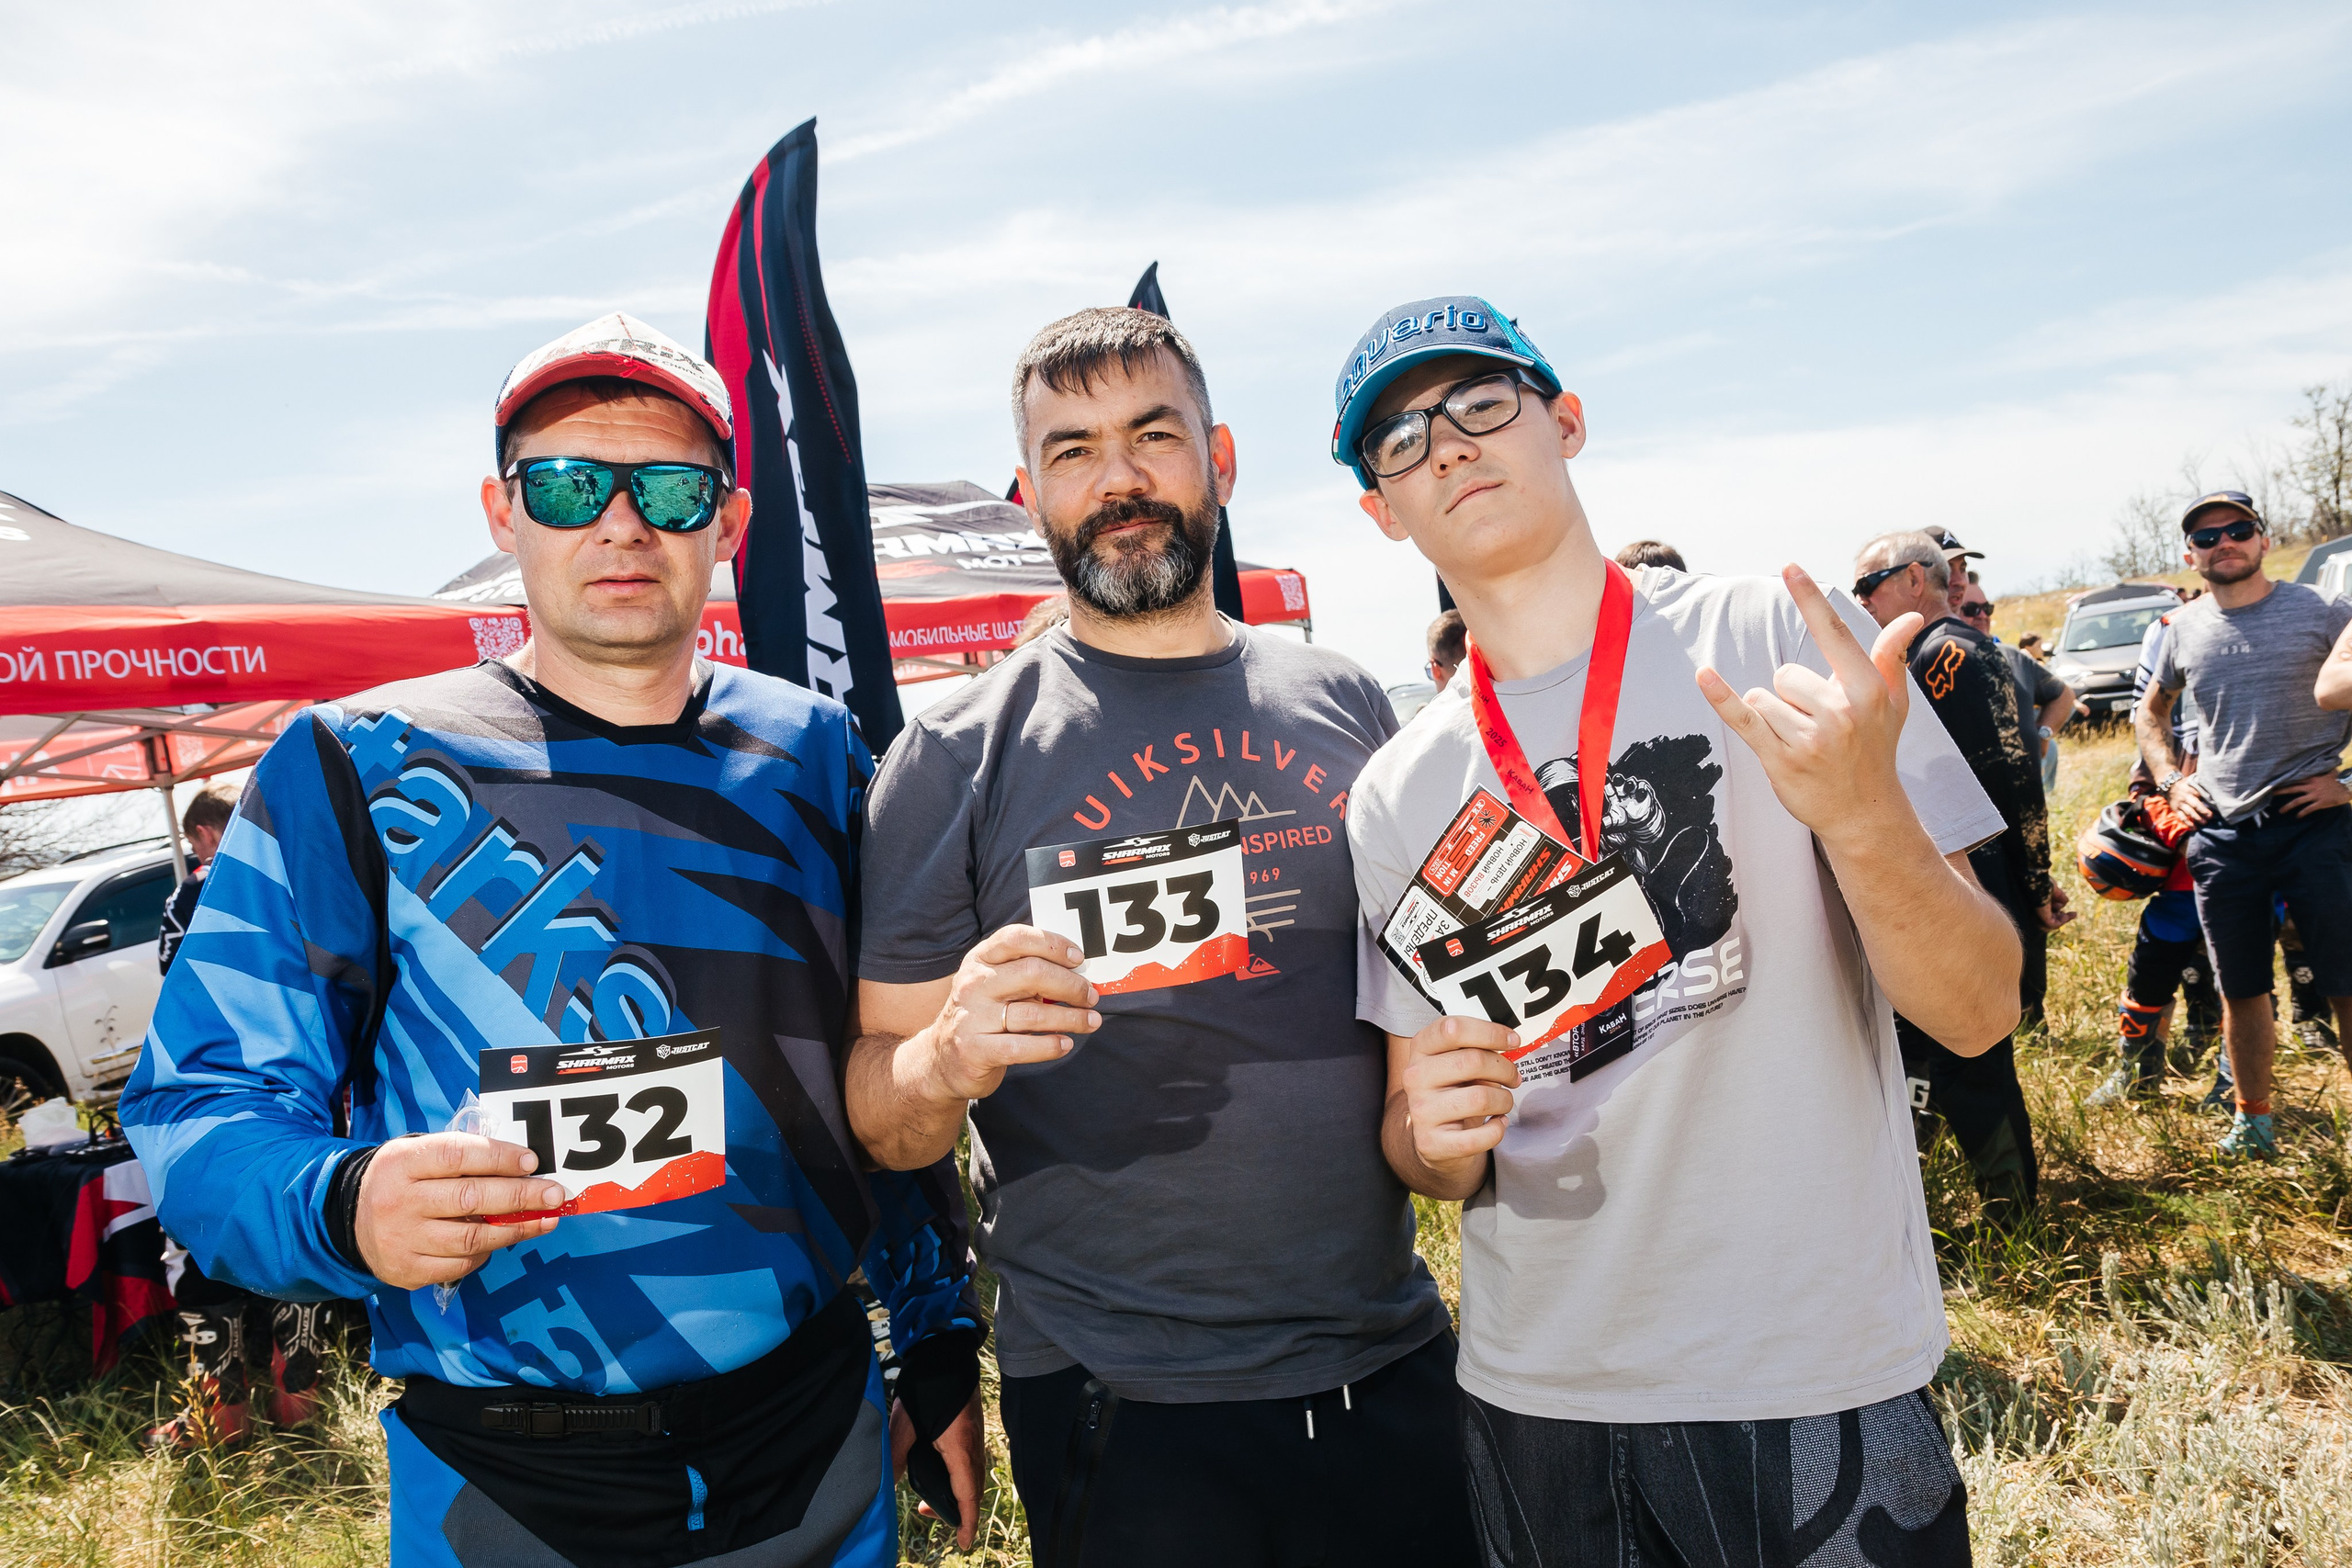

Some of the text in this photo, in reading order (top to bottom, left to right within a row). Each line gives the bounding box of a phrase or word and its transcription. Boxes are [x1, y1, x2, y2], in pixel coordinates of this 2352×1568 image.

[889, 619, 1026, 648] МОБИЛЬНЫЕ ШАТ
[54, 646, 266, 681] ПРОЧНОСТИ
[1486, 728, 1507, 748] 2025
[1102, 843, 1171, 861] SHARMAX
[1464, 831, 1486, 856] FREED
[1146, 852, 1170, 860] MOTORS
[1482, 846, 1504, 874] НОВЫЙ
[1490, 839, 1528, 885] НОВЫЙ ДЕНЬ
[1243, 867, 1281, 887] 969
[1464, 872, 1485, 897] ВЫЗОВ
[1064, 870, 1220, 959] 133
[1487, 904, 1553, 942] SHARMAX
[1530, 910, 1555, 927] MOTORS
[1403, 908, 1439, 957] ПРЕДЕЛЫ
[1434, 919, 1451, 935] ЗА
[1459, 911, 1636, 1029] 134
[1688, 1001, 1707, 1010] DOES
[1659, 1014, 1682, 1026] PLANET
[1692, 1009, 1705, 1019] THE
[556, 1055, 637, 1069] SHARMAX
[1520, 1059, 1535, 1067] STILL
[1535, 1055, 1552, 1064] DON'T
[1525, 1066, 1538, 1075] HAS
[1538, 1060, 1563, 1071] CREATED
[1530, 1073, 1543, 1082] ARE
[1543, 1070, 1554, 1078] THE
[513, 1087, 692, 1176] 132
